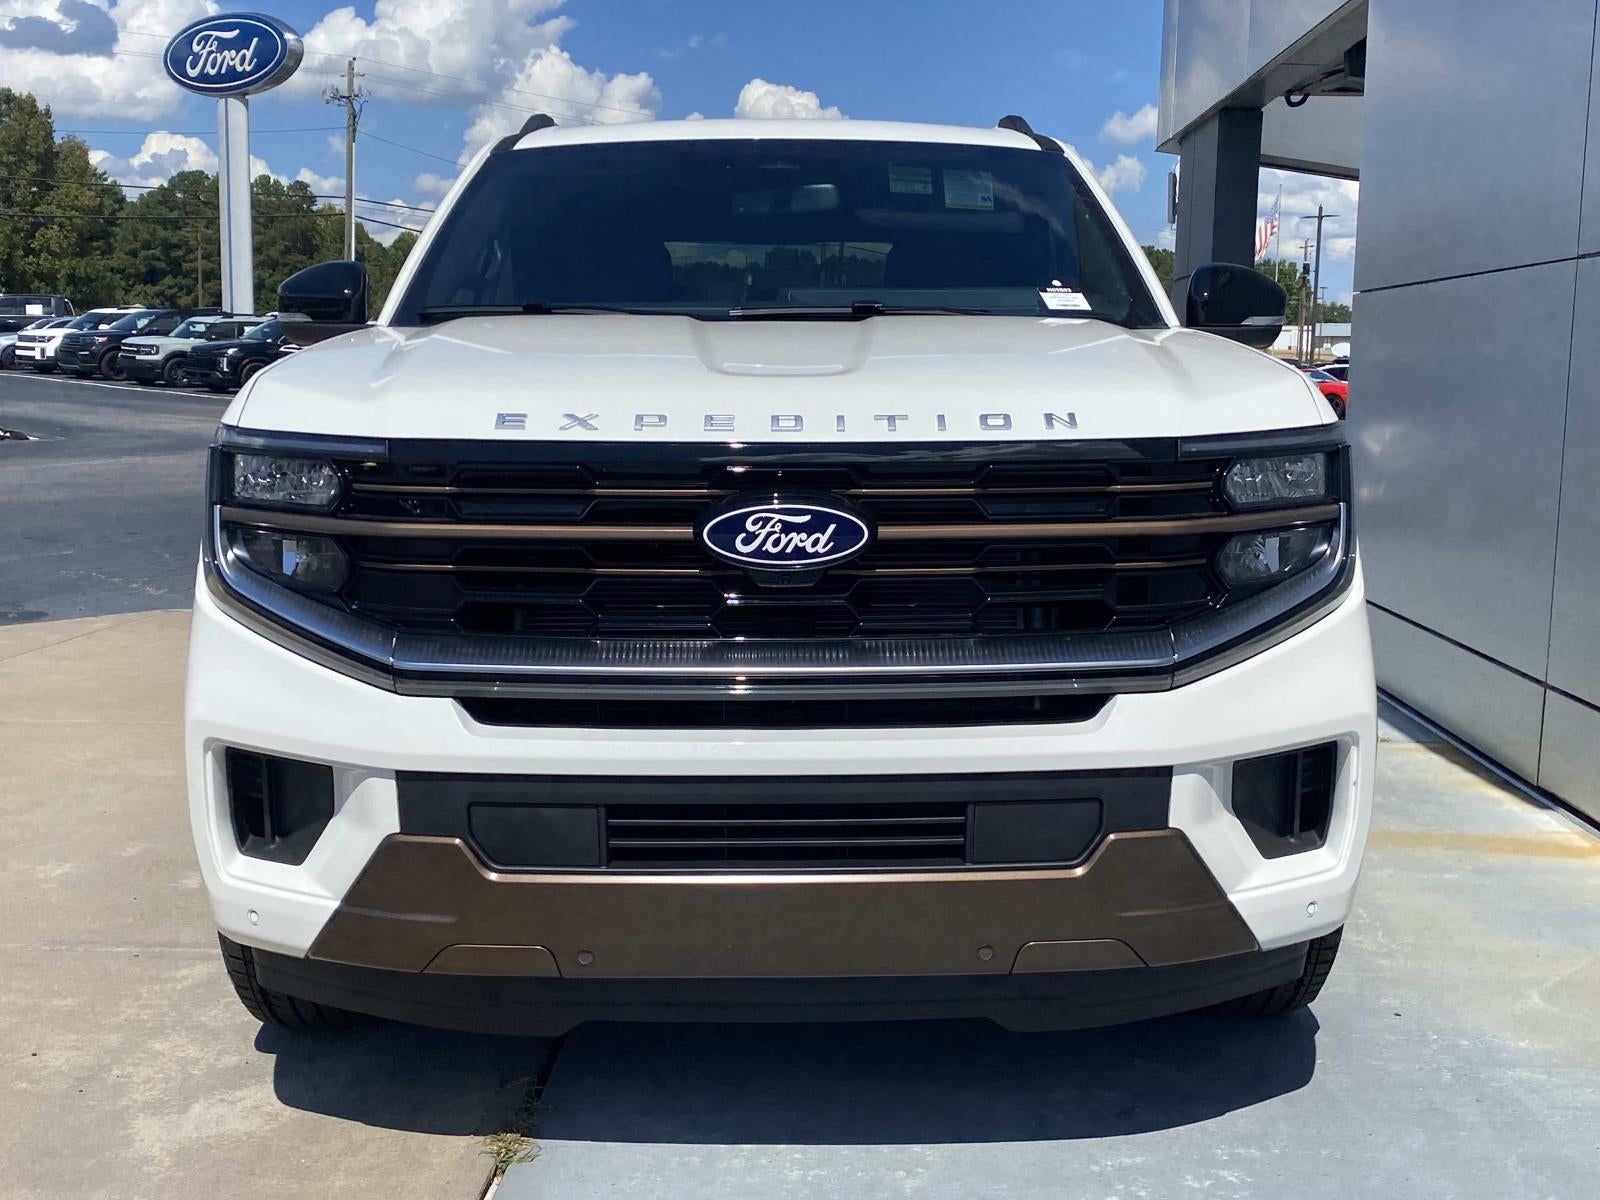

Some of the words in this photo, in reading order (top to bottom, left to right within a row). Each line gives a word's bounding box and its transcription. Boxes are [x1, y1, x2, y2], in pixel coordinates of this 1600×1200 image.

[185, 29, 259, 77] Ford
[494, 412, 1079, 433] EXPEDITION
[734, 511, 838, 557] Ford
